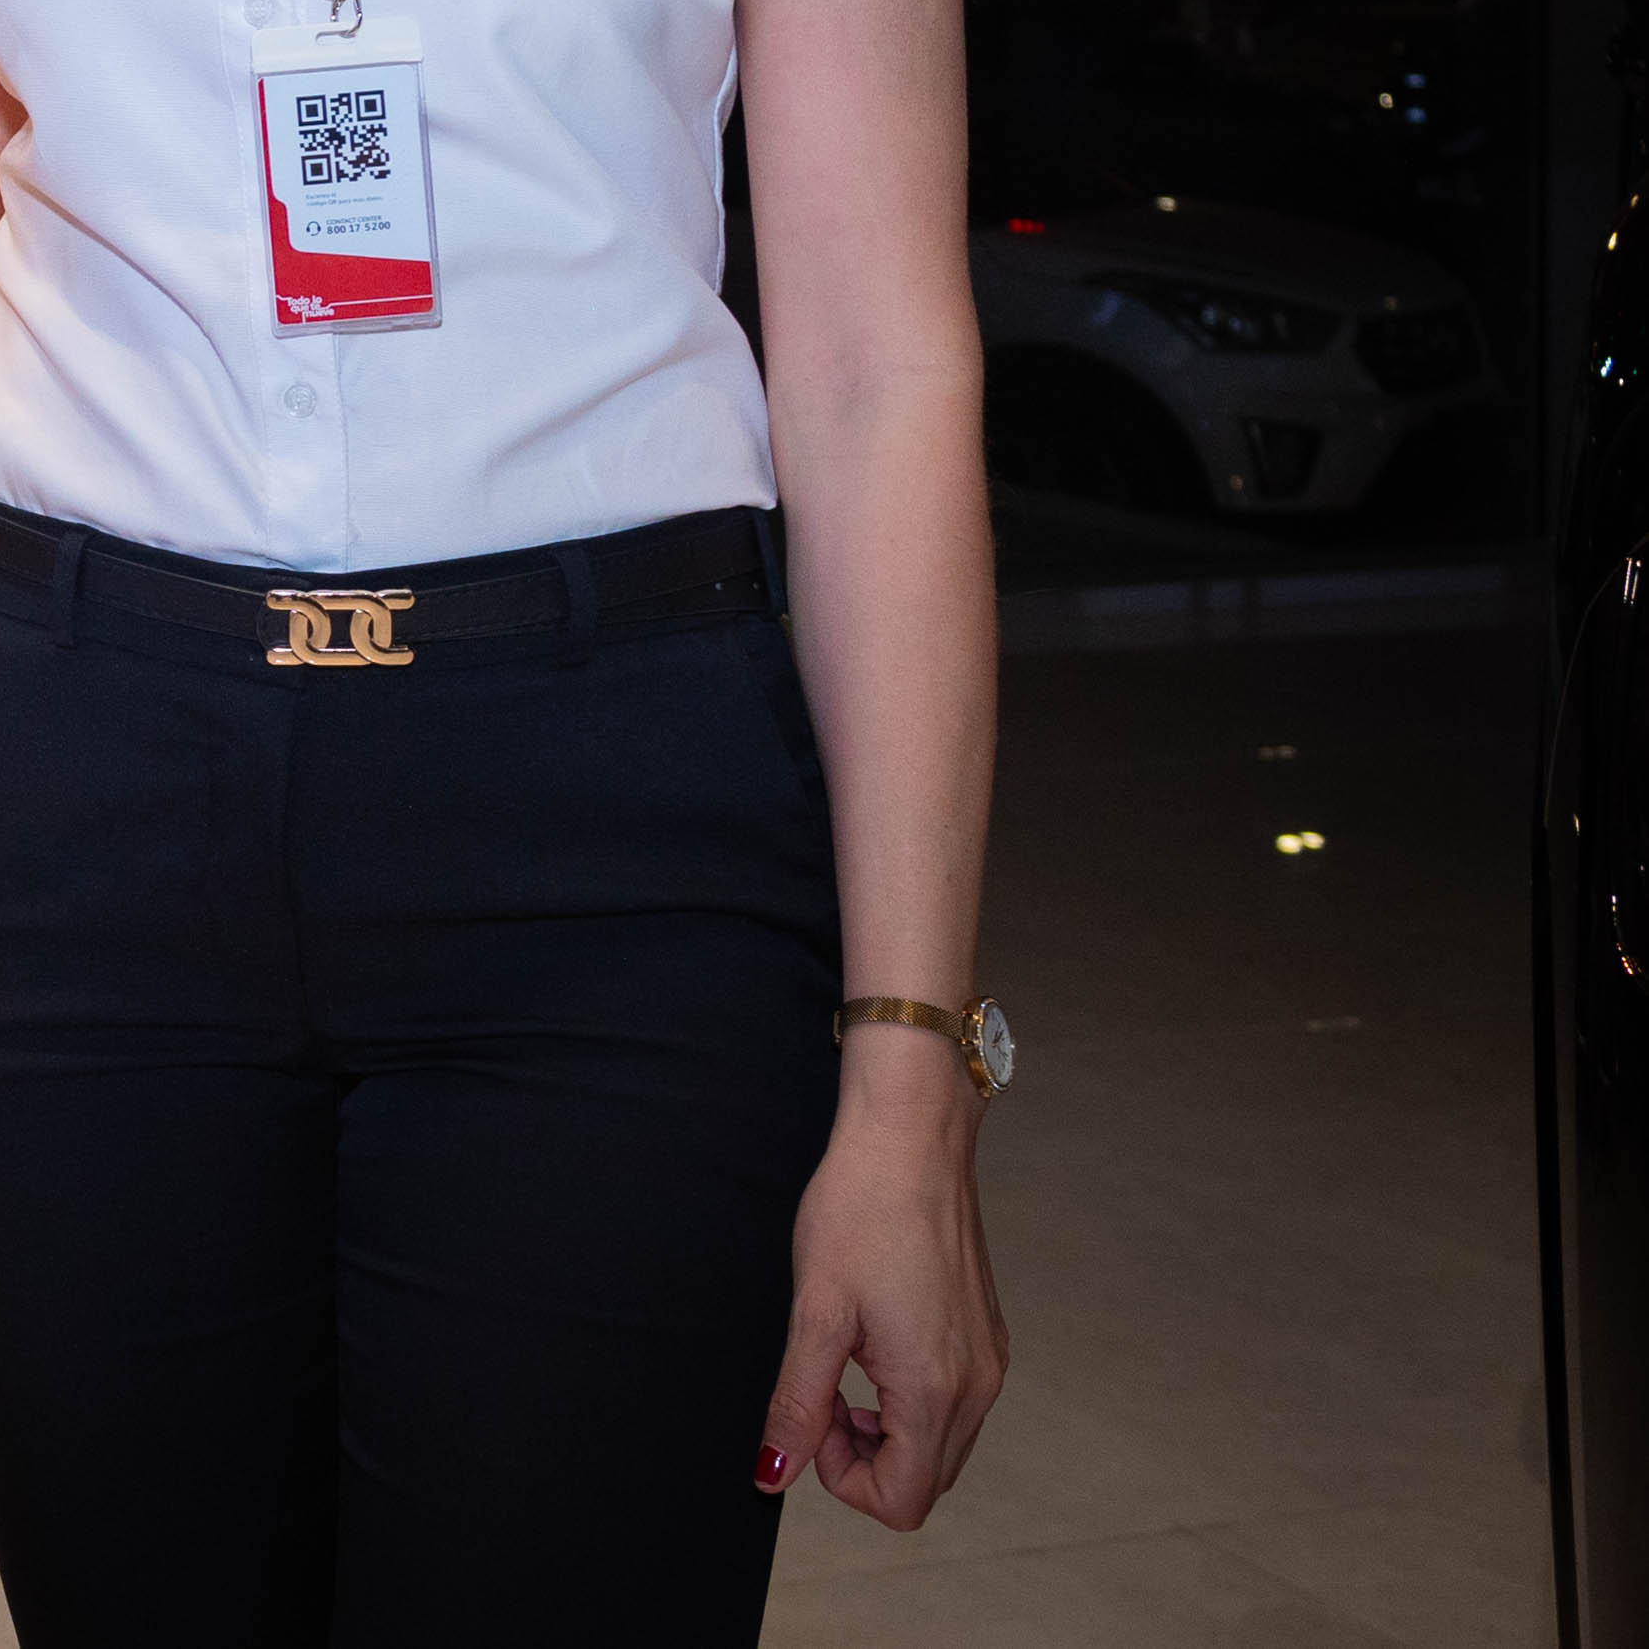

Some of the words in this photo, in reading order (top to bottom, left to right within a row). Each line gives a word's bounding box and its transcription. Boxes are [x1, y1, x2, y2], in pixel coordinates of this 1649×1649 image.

[327, 225, 347, 235] 800
[349, 223, 360, 233] 17
[364, 221, 391, 231] 5200
